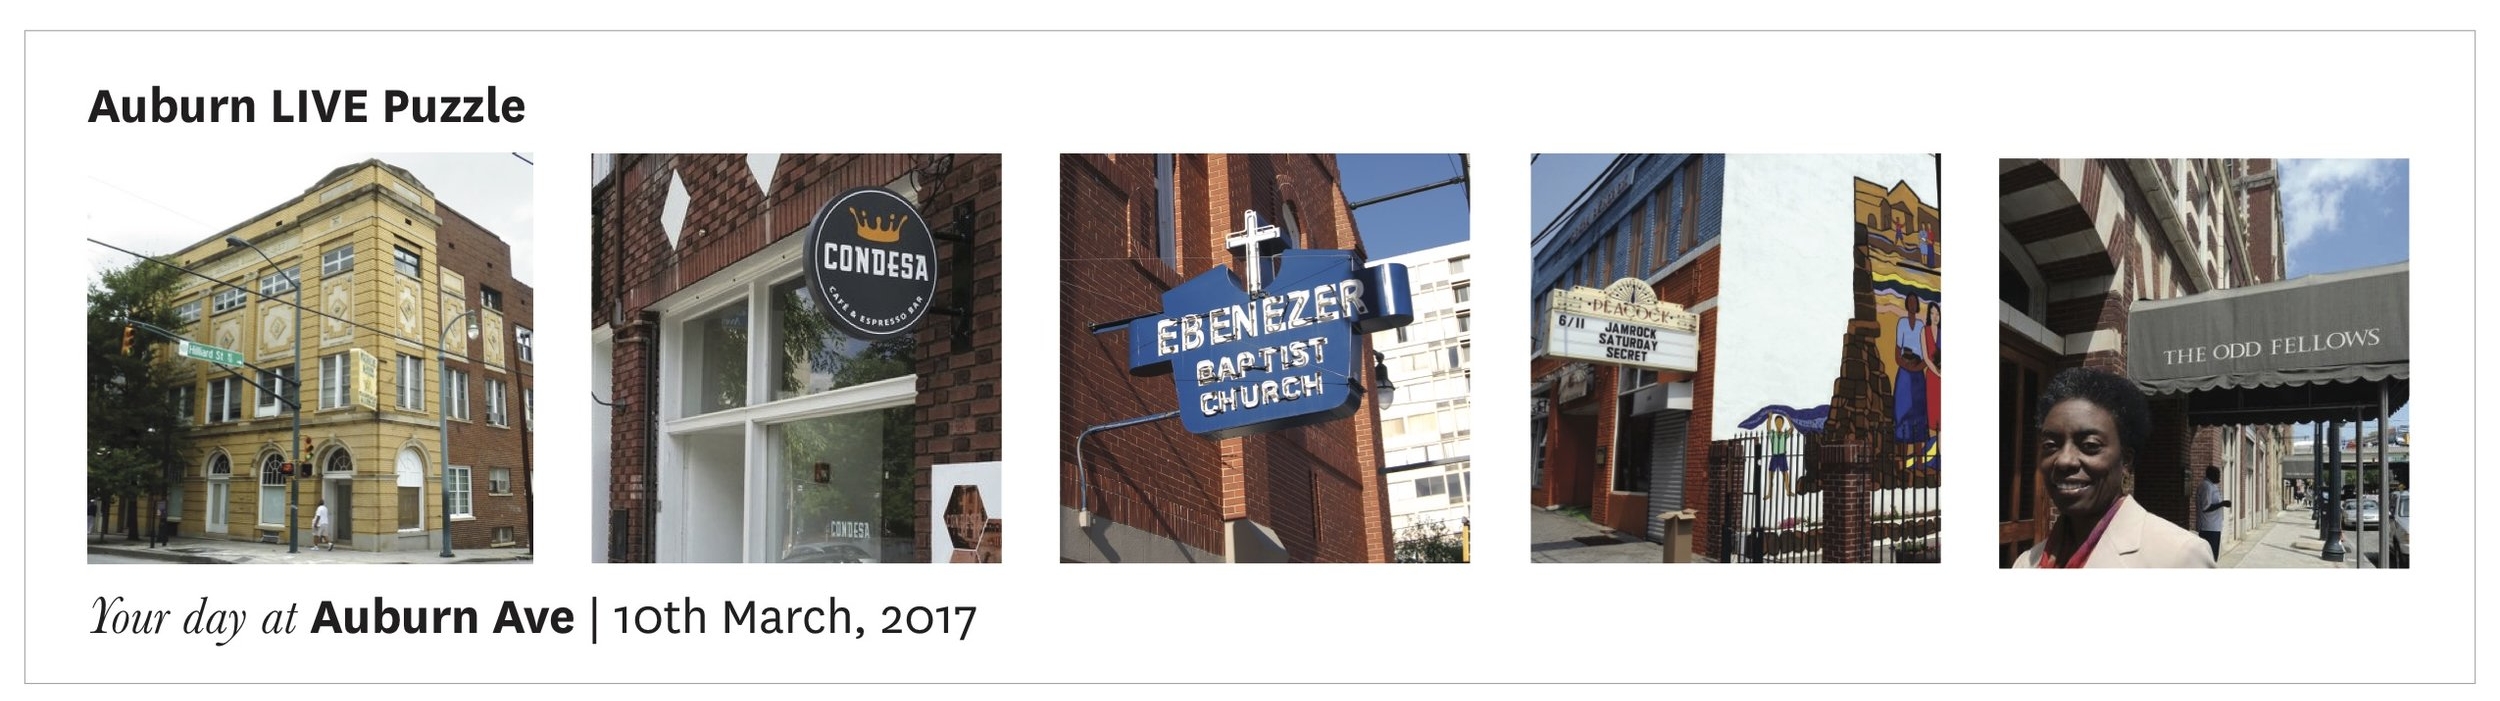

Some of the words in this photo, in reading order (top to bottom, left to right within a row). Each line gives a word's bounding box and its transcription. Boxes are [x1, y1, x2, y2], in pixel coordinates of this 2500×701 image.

[823, 241, 929, 281] CONDESA
[849, 310, 856, 319] &
[859, 312, 907, 327] ESPRESSO
[907, 295, 923, 315] BAR
[1157, 279, 1369, 356] EBENEZER
[1558, 314, 1585, 329] 6/11
[1592, 298, 1671, 324] PEACOCK
[1599, 333, 1658, 352] SATURDAY
[1605, 321, 1657, 340] JAMROCK
[215, 350, 224, 361] St
[1606, 346, 1648, 362] SECRET
[2163, 346, 2207, 366] THE
[2213, 340, 2262, 361] ODD
[2271, 328, 2381, 356] FELLOWS
[1196, 336, 1328, 387] BAPTIST
[1200, 371, 1324, 417] CHURCH
[830, 520, 870, 539] CONDESA
